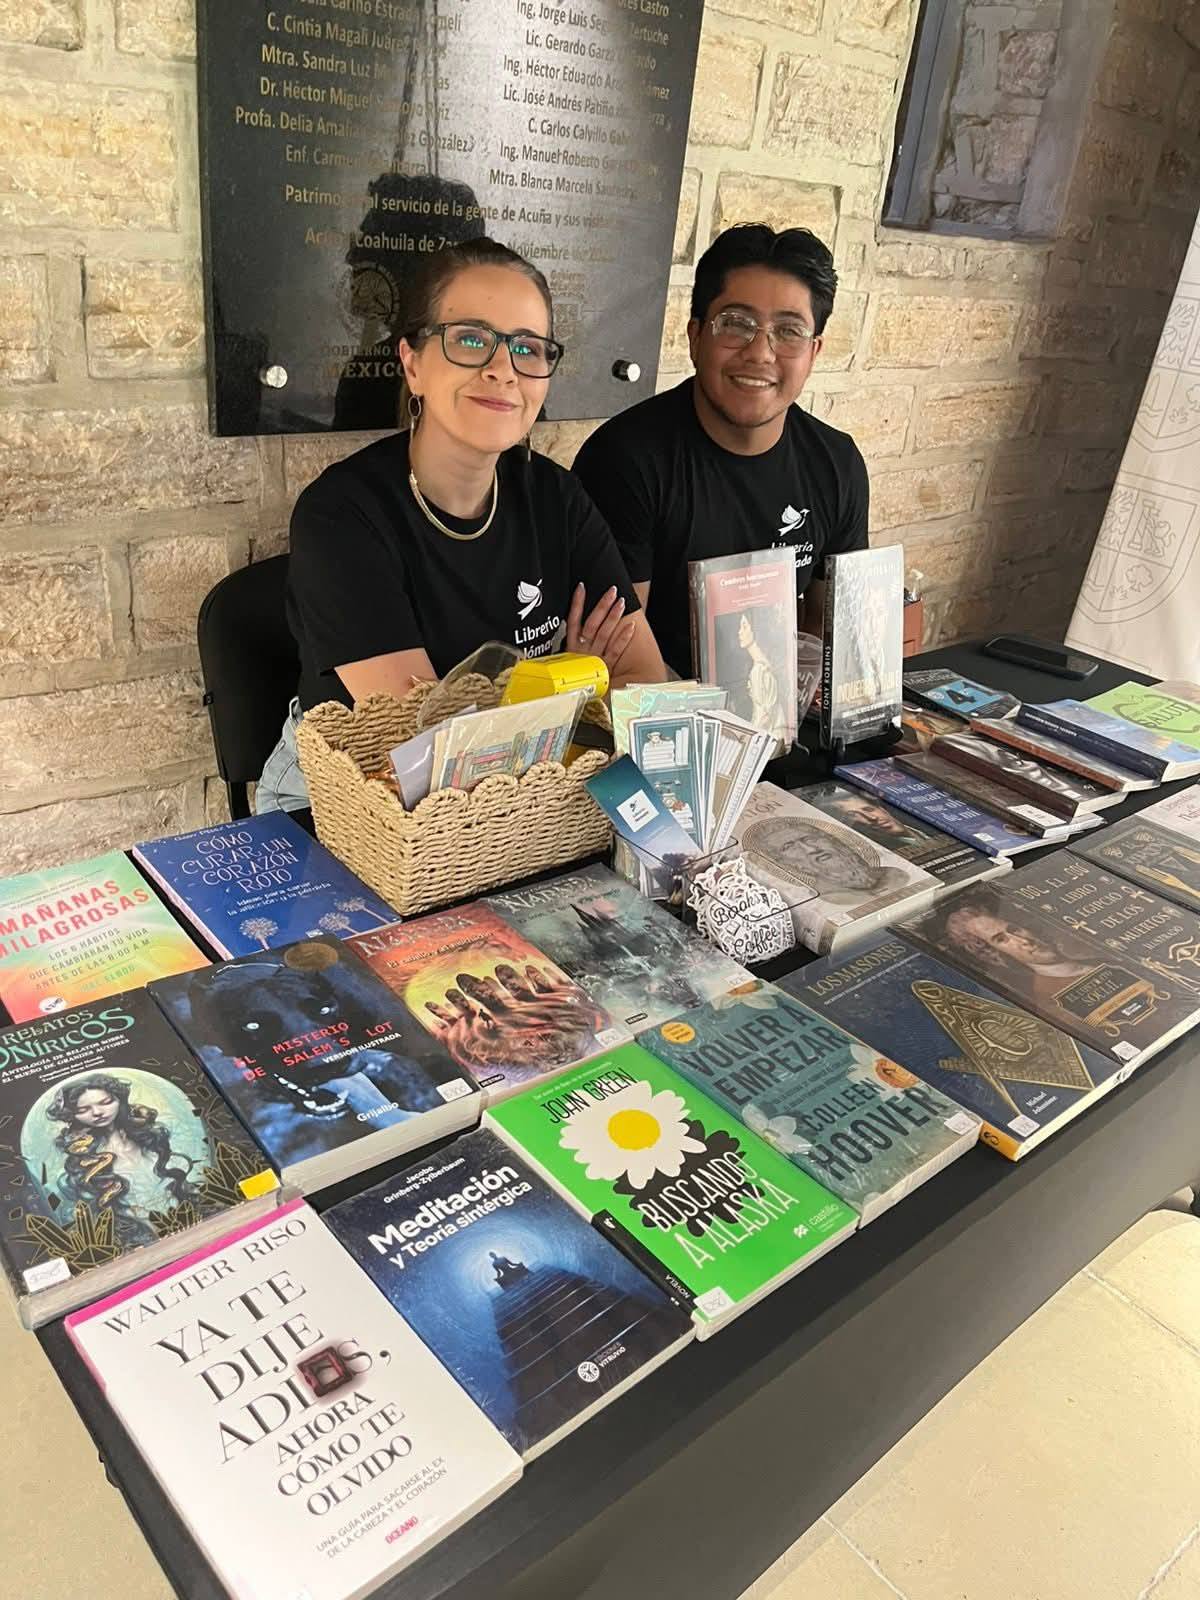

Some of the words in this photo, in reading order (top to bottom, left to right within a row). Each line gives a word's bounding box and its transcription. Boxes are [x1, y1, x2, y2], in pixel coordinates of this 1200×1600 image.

[267, 11, 280, 33] C.
[283, 14, 321, 39] Cintia
[539, 2, 566, 26] Jorge
[569, 12, 588, 30] Luis
[640, 0, 671, 17] Castro
[525, 28, 542, 49] Lic.
[545, 33, 586, 57] Gerardo
[261, 43, 299, 68] Mtra.
[303, 50, 347, 74] Sandra
[351, 57, 371, 79] Luz
[503, 53, 523, 78] Ing.
[526, 57, 561, 81] Héctor
[563, 64, 601, 89] Eduardo
[260, 75, 279, 97] Dr.
[330, 87, 370, 111] Miguel
[503, 82, 520, 102] Lic.
[523, 87, 545, 107] José
[547, 91, 582, 113] Andrés
[585, 98, 615, 117] Patiño
[234, 104, 277, 129] Profa.
[280, 111, 314, 135] Delia
[528, 116, 538, 135] C.
[540, 119, 571, 139] Carlos
[573, 123, 608, 144] Calvillo
[284, 143, 308, 164] Enf.
[499, 141, 521, 163] Ing.
[522, 143, 560, 166] Manuel
[561, 152, 601, 171] Roberto
[489, 168, 519, 188] Mtra.
[521, 172, 552, 192] Blanca
[555, 176, 593, 195] Marcela
[383, 196, 430, 216] servicio
[433, 198, 449, 217] de
[452, 200, 463, 218] la
[465, 206, 500, 224] gente
[502, 205, 516, 222] de
[519, 206, 551, 225] Acuña
[555, 213, 562, 227] y
[563, 211, 581, 226] sus
[355, 230, 415, 252] Coahuila
[418, 236, 435, 252] de
[823, 645, 832, 683] ROBBINS
[822, 688, 830, 710] TONY
[182, 845, 263, 875] CURAR
[264, 837, 294, 853] UN
[196, 831, 254, 856] CÓMO
[202, 851, 300, 887] CORAZÓN
[238, 868, 293, 894] ROTO
[1061, 884, 1098, 905] LIBRO
[1076, 892, 1123, 919] EGIPCIO
[1100, 911, 1120, 930] DE
[1118, 902, 1145, 922] LOS
[1120, 911, 1172, 944] MUERTOS
[126, 926, 149, 942] VIDA
[731, 925, 778, 957] Coffee
[806, 968, 842, 998] LOS
[838, 940, 909, 984] MASONES
[0, 1009, 95, 1046] RELATOS
[233, 1054, 256, 1069] EL
[272, 1021, 350, 1055] MISTERIO
[357, 1032, 402, 1054] ILUSTRADA
[681, 1013, 790, 1079] VOLVER
[789, 1002, 818, 1029] A
[44, 1060, 58, 1072] DE
[51, 1052, 65, 1064] DE
[66, 1043, 100, 1060] RELATOS
[242, 1065, 267, 1082] DE
[366, 1021, 394, 1038] LOT
[712, 1026, 851, 1106] EMPEZAR
[356, 1100, 400, 1123] Grijalbo
[540, 1088, 591, 1124] JOHN
[583, 1067, 639, 1105] GREEN
[801, 1075, 883, 1136] COLLEEN
[808, 1084, 948, 1181] HOOVER
[404, 1165, 435, 1184] Jacobo
[636, 1151, 758, 1233] BUSCANDO
[367, 1163, 520, 1256] Meditación
[389, 1252, 406, 1271] y
[400, 1223, 460, 1258] Teoría
[458, 1180, 534, 1229] sintérgica
[687, 1178, 800, 1253] ALASKA
[674, 1231, 716, 1269] A
[103, 1259, 237, 1336] WALTER
[241, 1218, 308, 1264] RISO
[664, 1273, 691, 1300] NOVELA
[150, 1318, 236, 1368] YA
[228, 1270, 307, 1323] TE
[194, 1312, 326, 1406] DIJE
[598, 1346, 627, 1369] VITRUVIO
[274, 1390, 376, 1466] AHORA
[277, 1430, 362, 1497] CÓMO
[359, 1402, 407, 1439] TE
[306, 1433, 414, 1517] OLVIDO
[316, 1534, 337, 1553] UNA
[337, 1519, 361, 1539] GUÍA
[361, 1502, 385, 1524] PARA
[384, 1476, 422, 1508] SACARSE
[419, 1466, 434, 1482] AL
[432, 1455, 447, 1472] EX
[326, 1545, 343, 1560] DE
[342, 1538, 355, 1550] LA
[353, 1513, 389, 1542] CABEZA
[387, 1505, 397, 1518] Y
[406, 1466, 450, 1504] CORAZÓN
